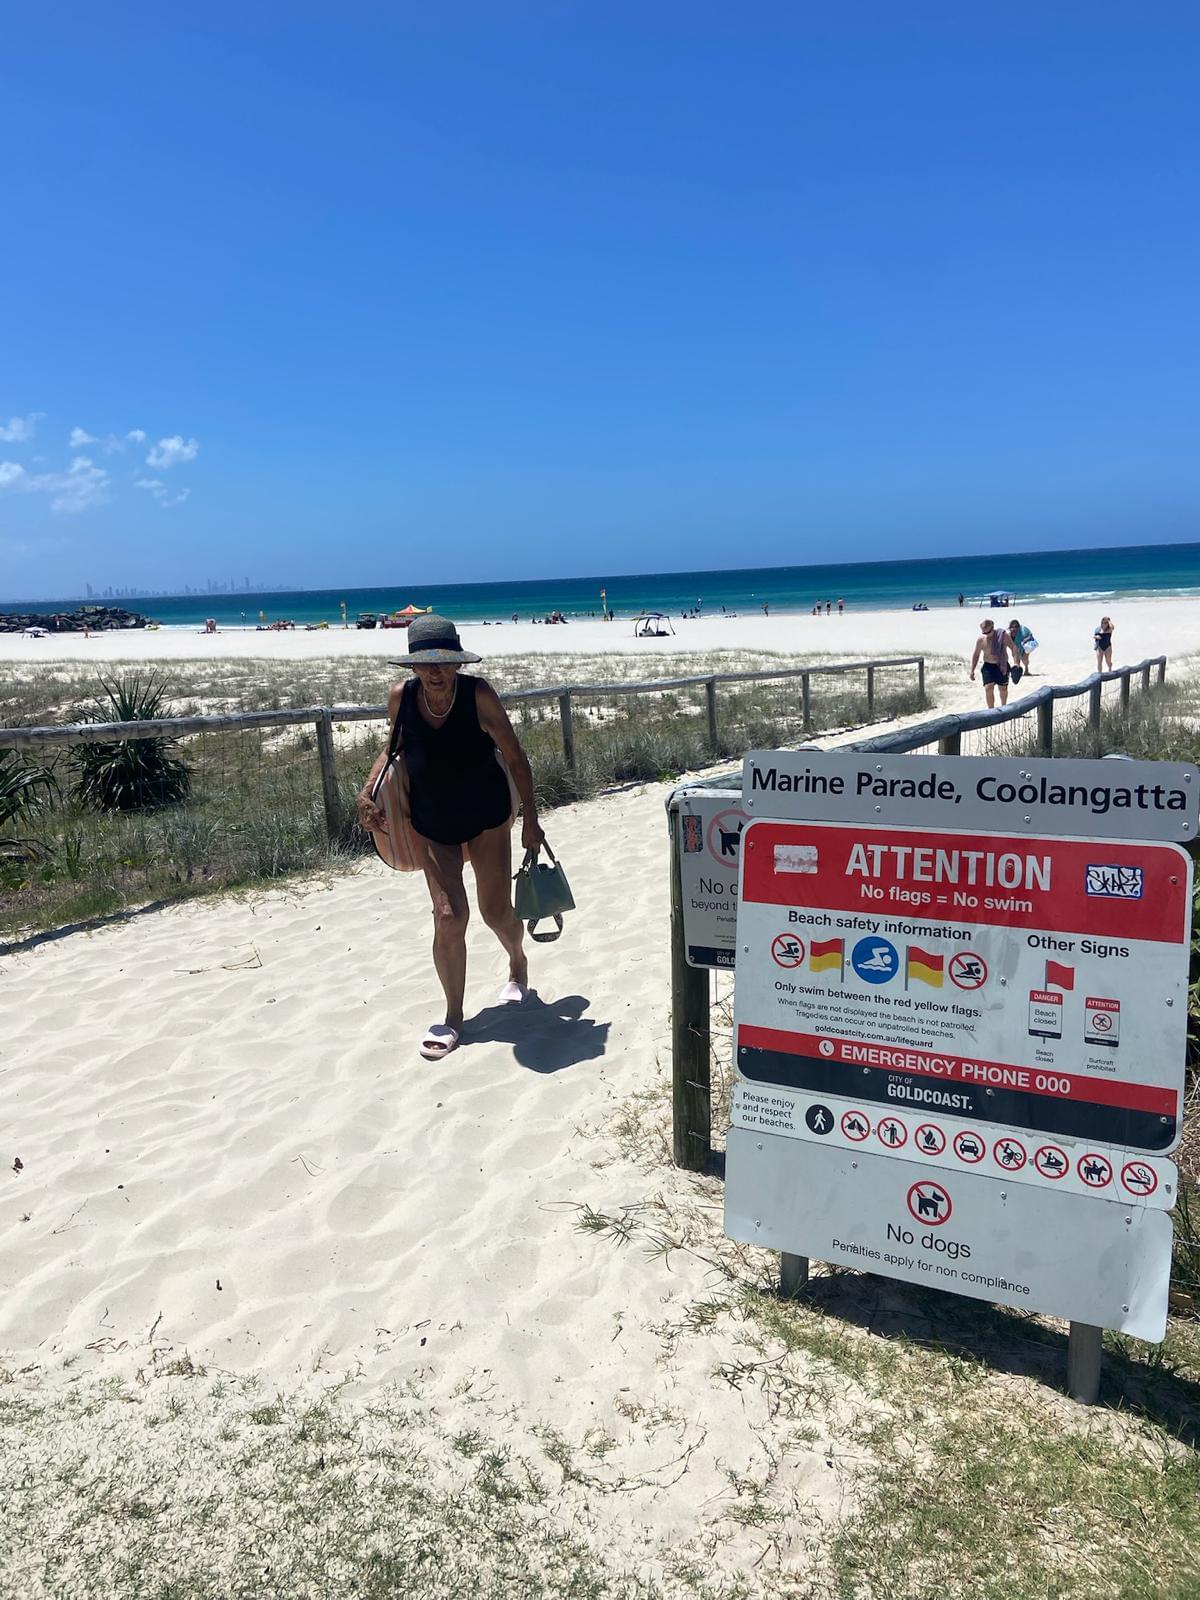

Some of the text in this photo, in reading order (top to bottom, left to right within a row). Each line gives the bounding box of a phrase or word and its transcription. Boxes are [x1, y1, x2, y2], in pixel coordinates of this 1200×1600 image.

[752, 768, 1187, 814] Marine Parade, Coolangatta
[845, 843, 1052, 892] ATTENTION
[700, 877, 724, 895] No
[691, 898, 729, 912] beyond
[861, 884, 1033, 913] No flags = No swim
[788, 910, 972, 941] Beach safety information
[1027, 934, 1130, 958] Other Signs
[774, 981, 983, 1018] Only swim between the red yellow flags.
[1033, 992, 1060, 1002] DANGER
[1087, 999, 1119, 1010] ATTENTION
[777, 997, 797, 1007] When
[799, 1001, 816, 1010] flags
[830, 1005, 842, 1013] not
[843, 1006, 878, 1018] displayed
[879, 1012, 892, 1020] the
[892, 1013, 917, 1024] beach
[917, 1017, 925, 1025] is
[926, 1019, 939, 1027] not
[940, 1021, 977, 1032] patrolled.
[1033, 1017, 1057, 1026] closed
[1034, 1008, 1057, 1018] Beach
[795, 1009, 956, 1039] Tragedies can occur on unpatrolled beaches.
[814, 1025, 934, 1048] goldcoastcity.com.au/lifeguard
[1034, 1055, 1055, 1064] closed
[1035, 1048, 1055, 1057] Beach
[1088, 1057, 1114, 1067] Surfcraft
[841, 1044, 1071, 1094] EMERGENCY PHONE 000
[1086, 1063, 1116, 1073] prohibited
[888, 1074, 913, 1085] CITY OF
[742, 1091, 796, 1111] Please enjoy
[742, 1103, 792, 1119] and respect
[742, 1114, 796, 1130] our beaches.
[887, 1223, 972, 1259] No dogs
[832, 1238, 1031, 1295] Penalties apply for non compliance
